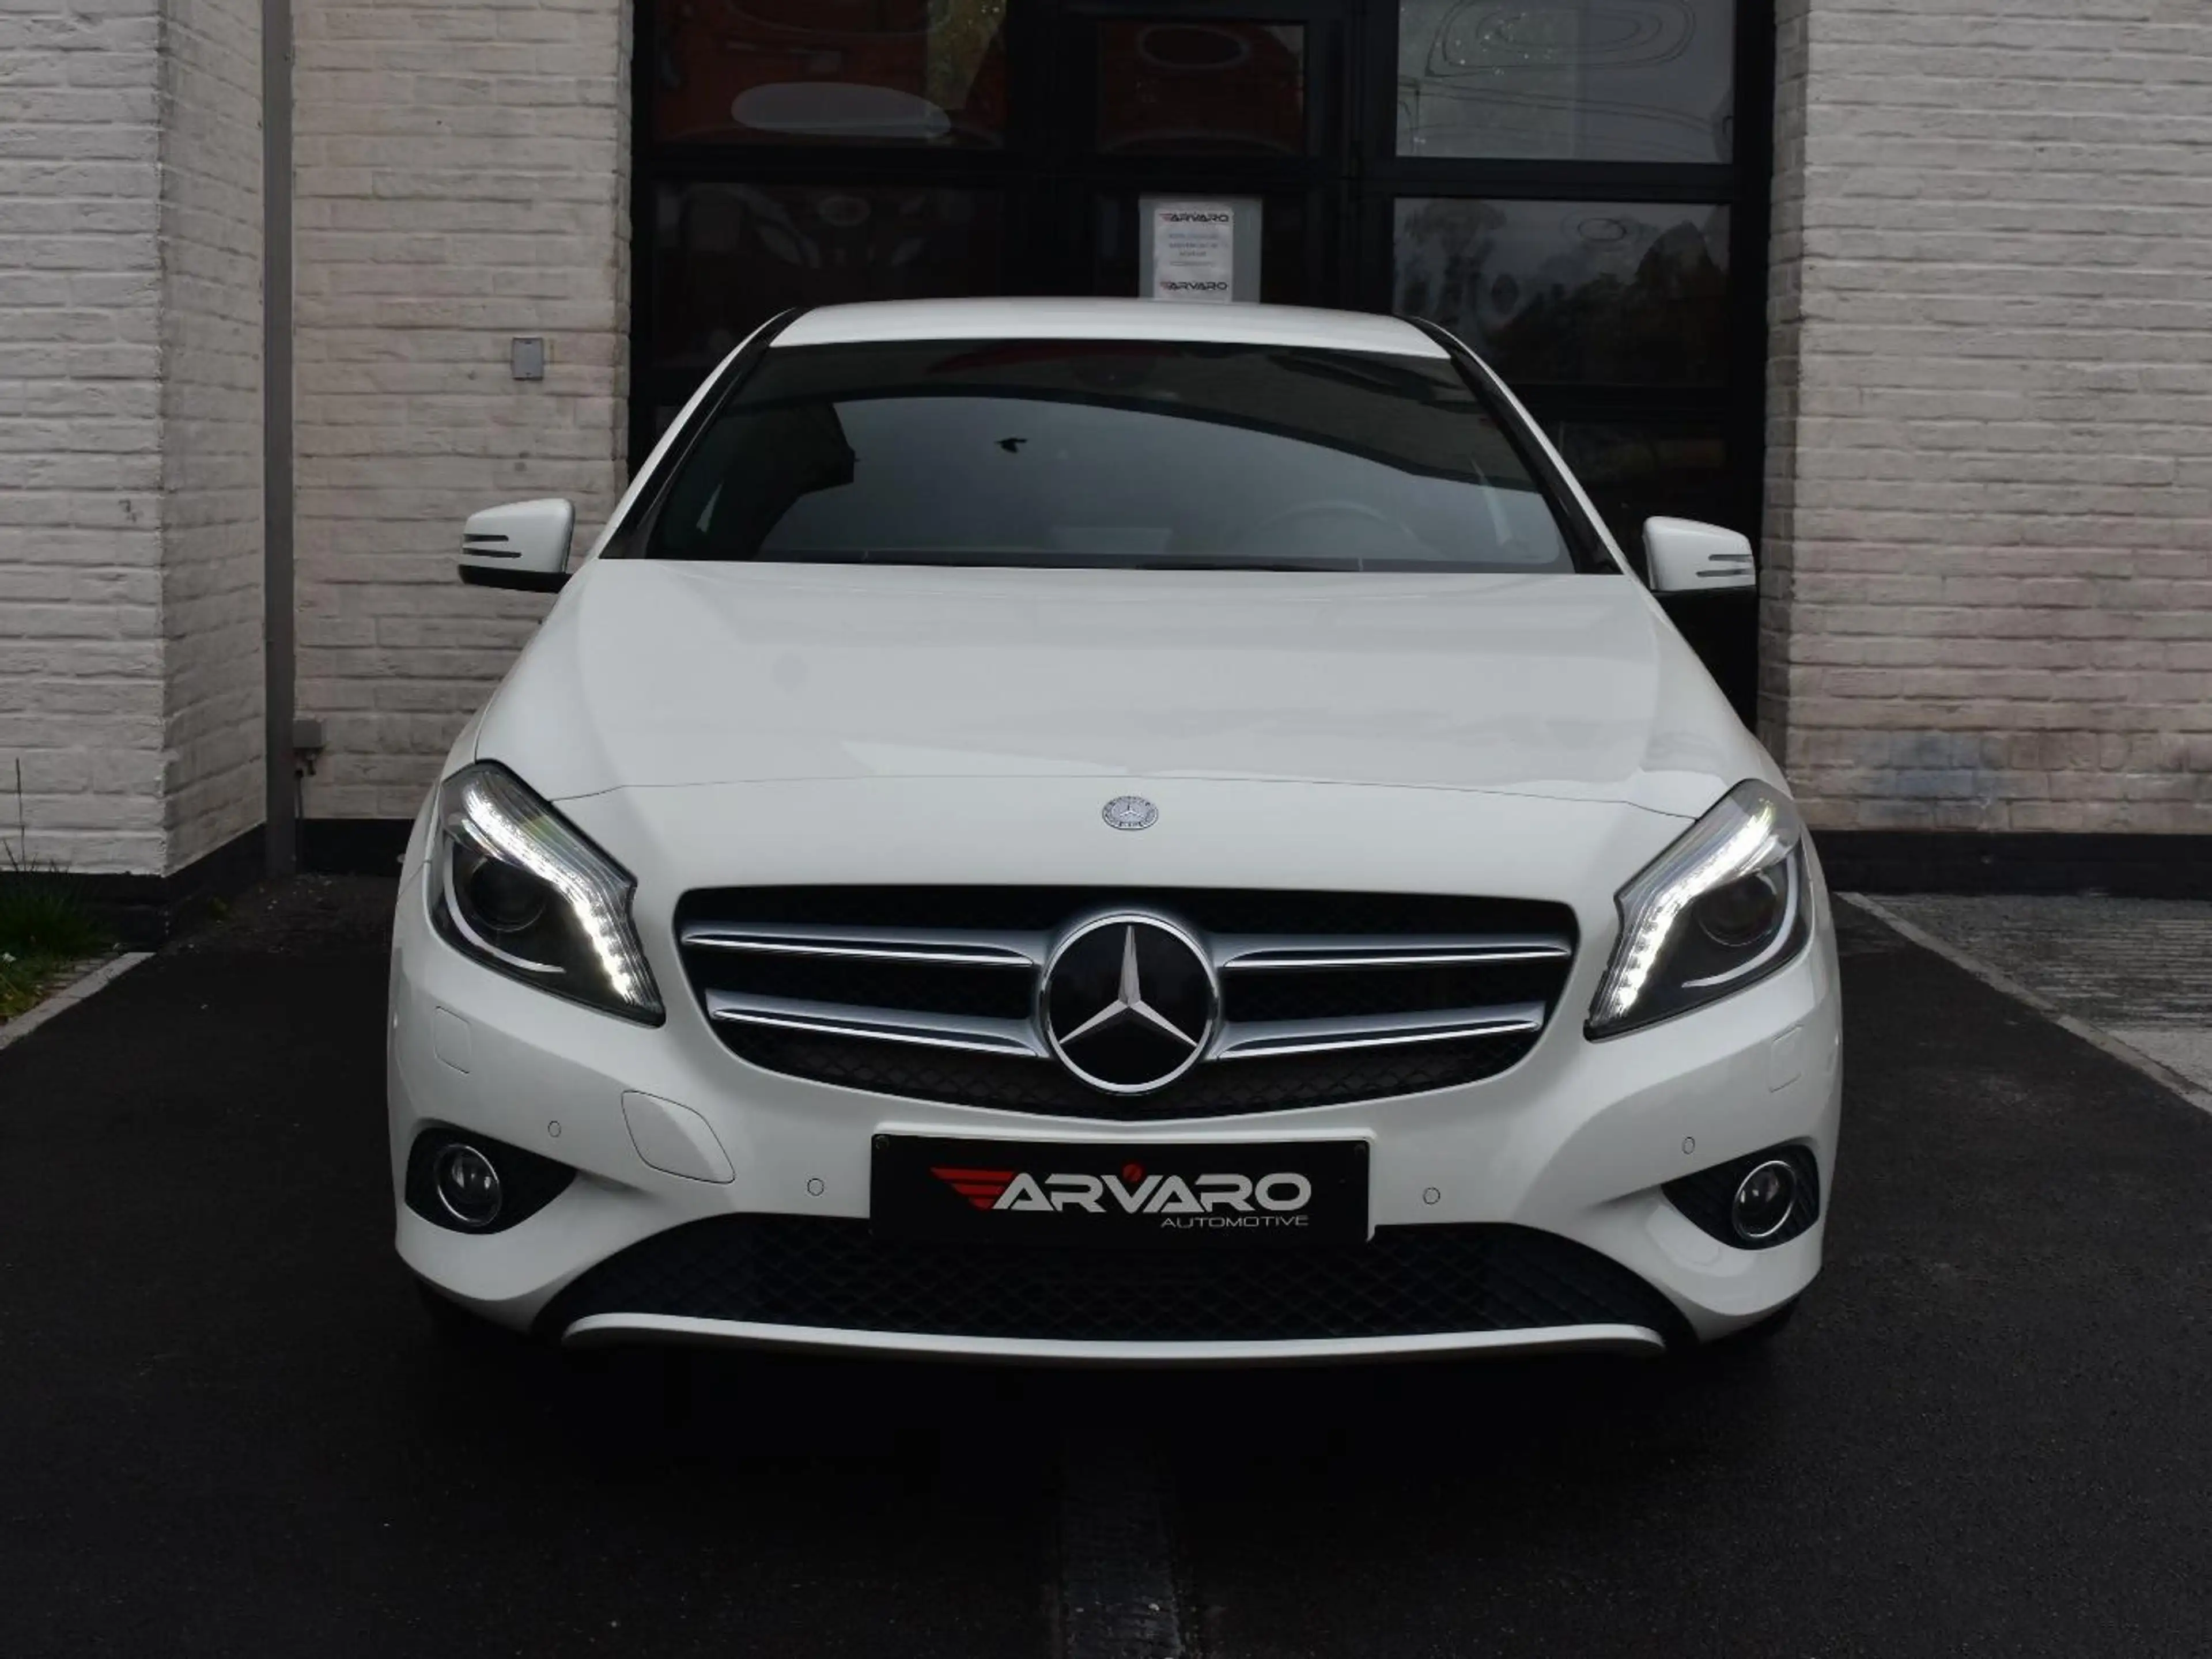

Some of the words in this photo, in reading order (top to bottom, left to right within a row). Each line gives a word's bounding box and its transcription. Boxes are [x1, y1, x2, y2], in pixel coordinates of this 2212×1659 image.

[1170, 214, 1229, 222] ARVARO
[1169, 282, 1228, 290] ARVARO
[992, 1172, 1312, 1213] ARVARO
[1160, 1214, 1309, 1229] AUTOMOTIVE
